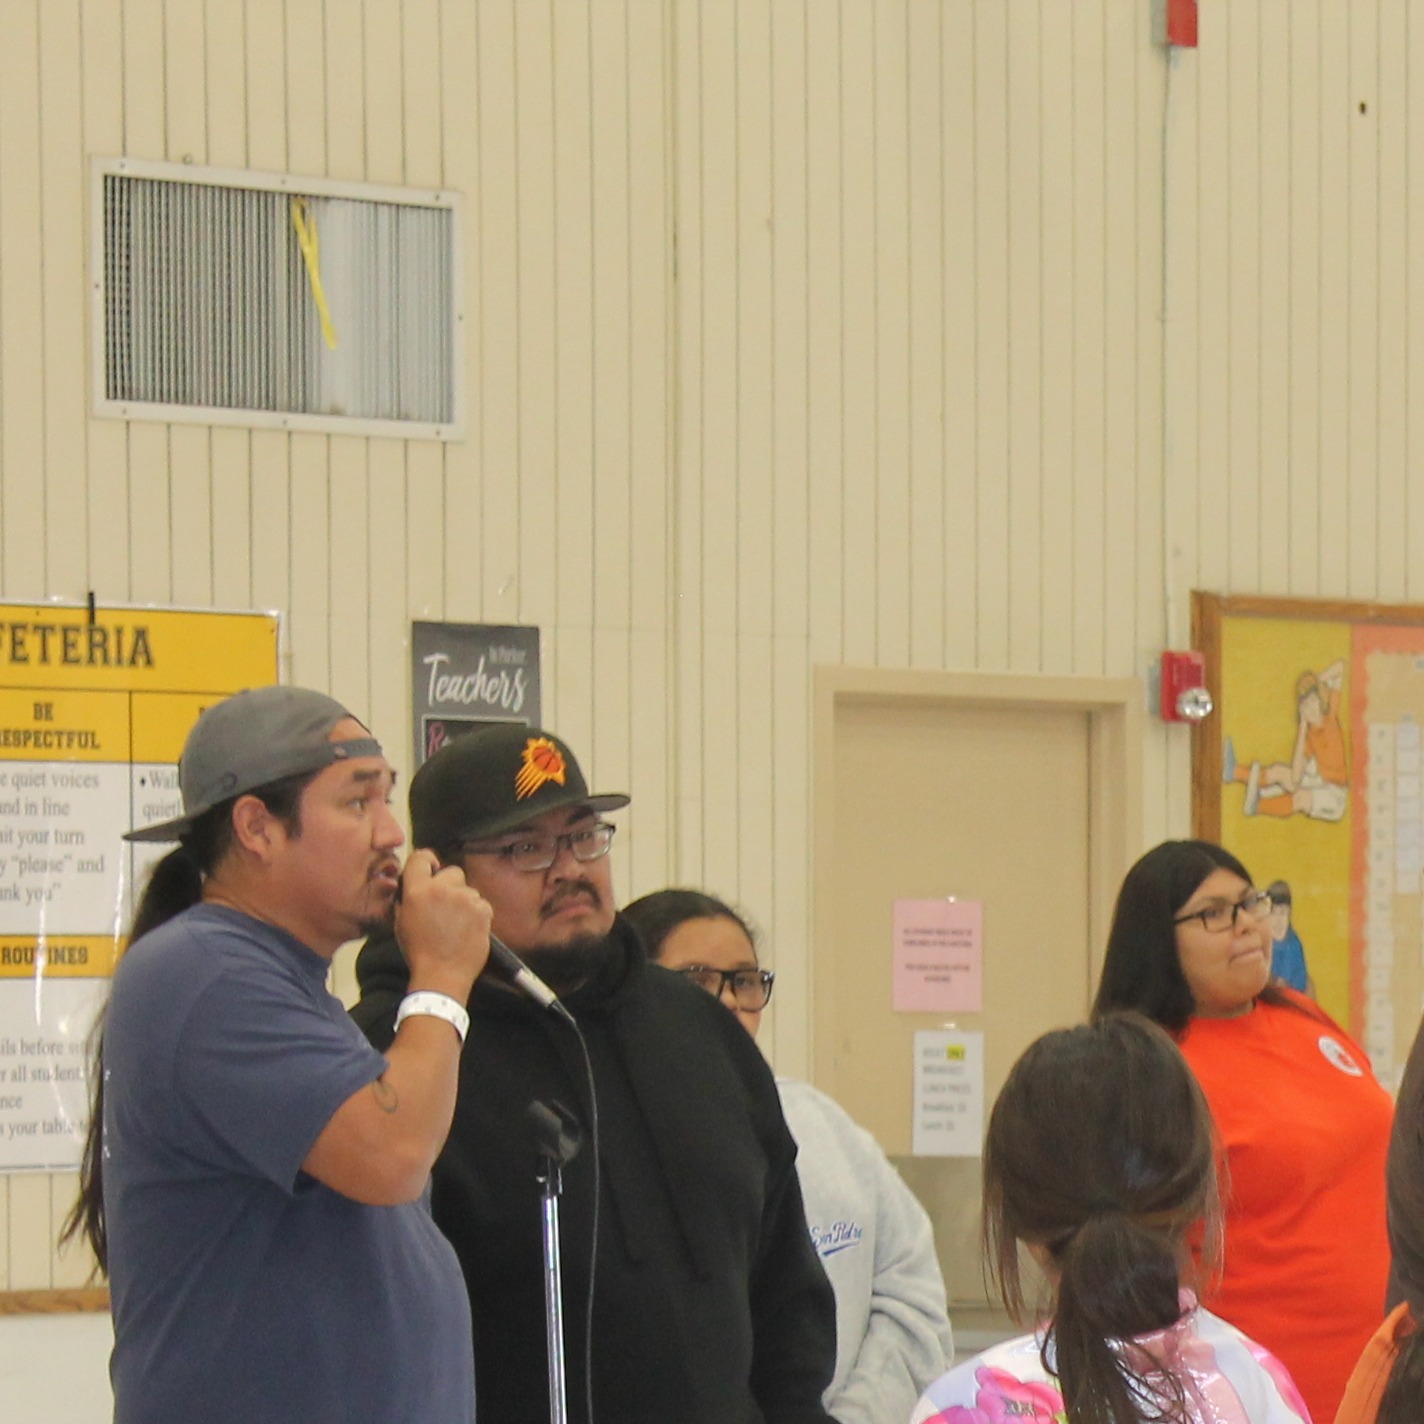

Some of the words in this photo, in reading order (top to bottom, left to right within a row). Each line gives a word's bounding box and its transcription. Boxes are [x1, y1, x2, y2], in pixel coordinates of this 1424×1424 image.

[33, 702, 54, 721] BE
[0, 729, 101, 750] ESPECTFUL
[11, 769, 46, 792] quiet
[51, 771, 99, 789] voices
[25, 797, 38, 816] in
[43, 798, 70, 817] line
[17, 831, 49, 850] your
[54, 829, 85, 845] turn
[77, 855, 104, 873] and
[2, 946, 88, 966] ROUINES
[20, 1037, 63, 1056] before
[11, 1063, 26, 1083] all
